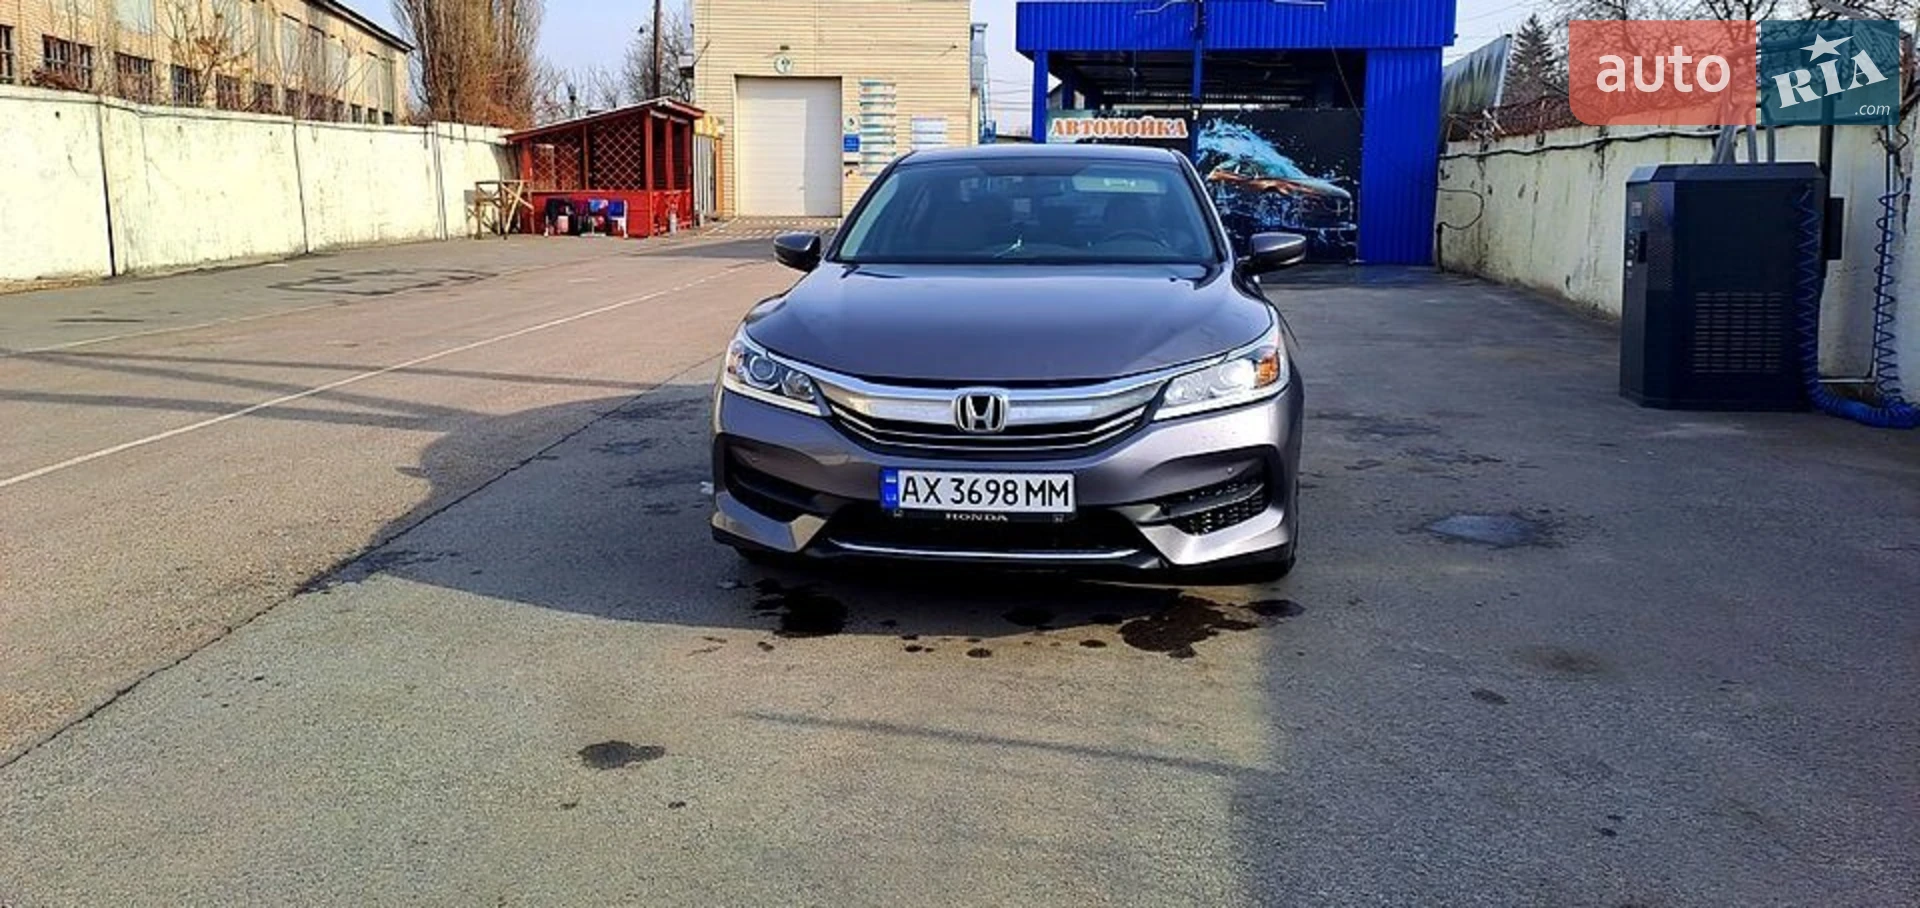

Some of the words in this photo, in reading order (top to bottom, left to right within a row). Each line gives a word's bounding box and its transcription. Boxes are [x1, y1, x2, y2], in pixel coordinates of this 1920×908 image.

[1051, 116, 1188, 138] АВТОМОЙКА
[901, 475, 942, 504] AX
[950, 478, 1018, 506] 3698
[1025, 479, 1069, 507] MM
[945, 512, 1009, 521] HONDA
